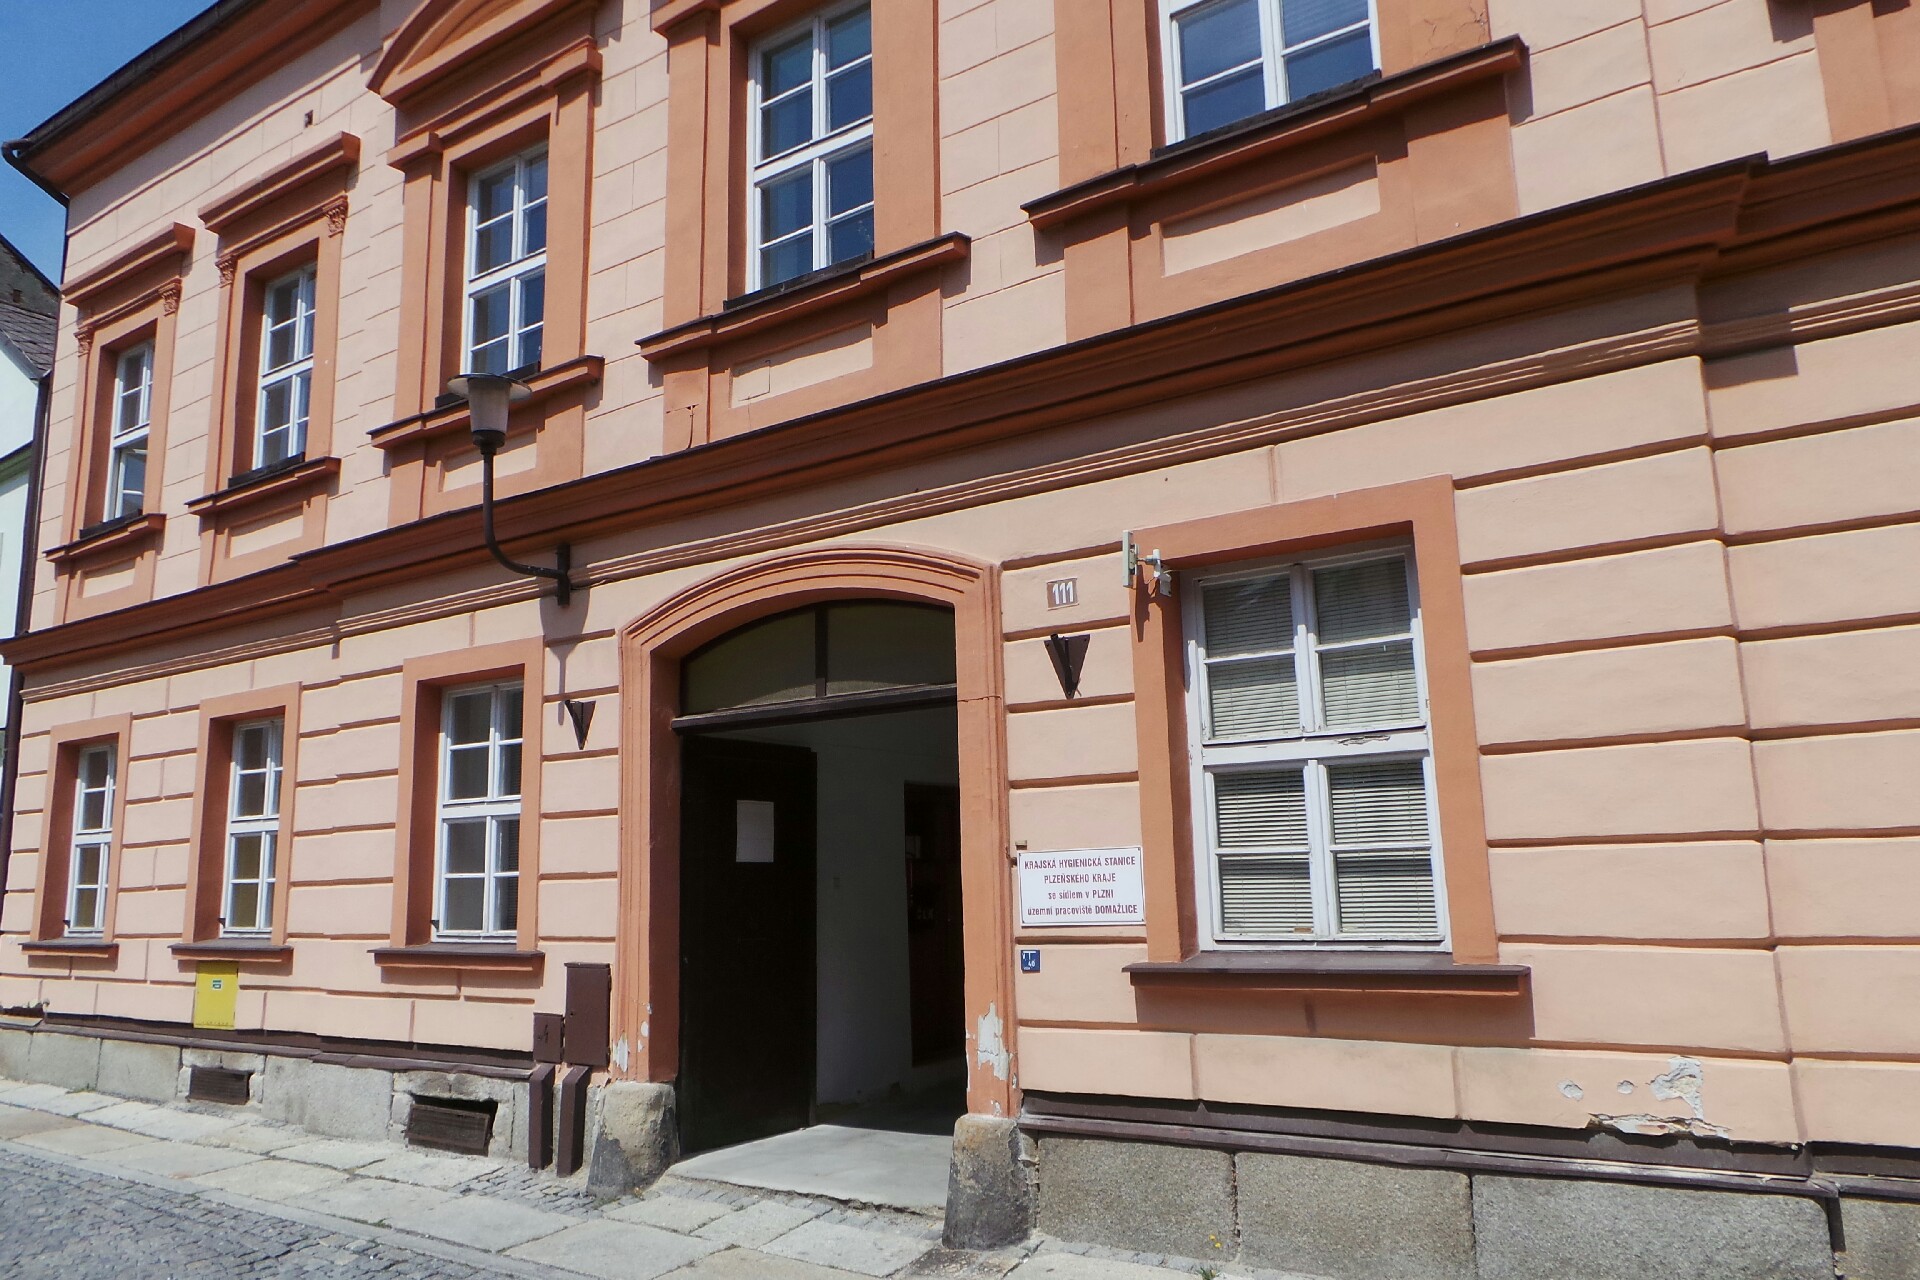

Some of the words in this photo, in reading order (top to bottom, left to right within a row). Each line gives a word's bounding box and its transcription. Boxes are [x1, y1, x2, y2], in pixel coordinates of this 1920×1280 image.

[1053, 581, 1074, 605] 111
[1024, 858, 1057, 870] KRAJSKÁ
[1059, 856, 1102, 869] HYGIENICKÁ
[1104, 856, 1136, 866] STANICE
[1044, 872, 1090, 884] PLZEŇSKÉHO
[1092, 873, 1116, 883] KRAJE
[1048, 892, 1057, 900] se
[1059, 889, 1083, 900] sídlem
[1085, 890, 1090, 899] v
[1092, 889, 1114, 899] PLZNI
[1055, 904, 1093, 916] pracoviště
[1095, 903, 1138, 915] DOMAŽLICE
